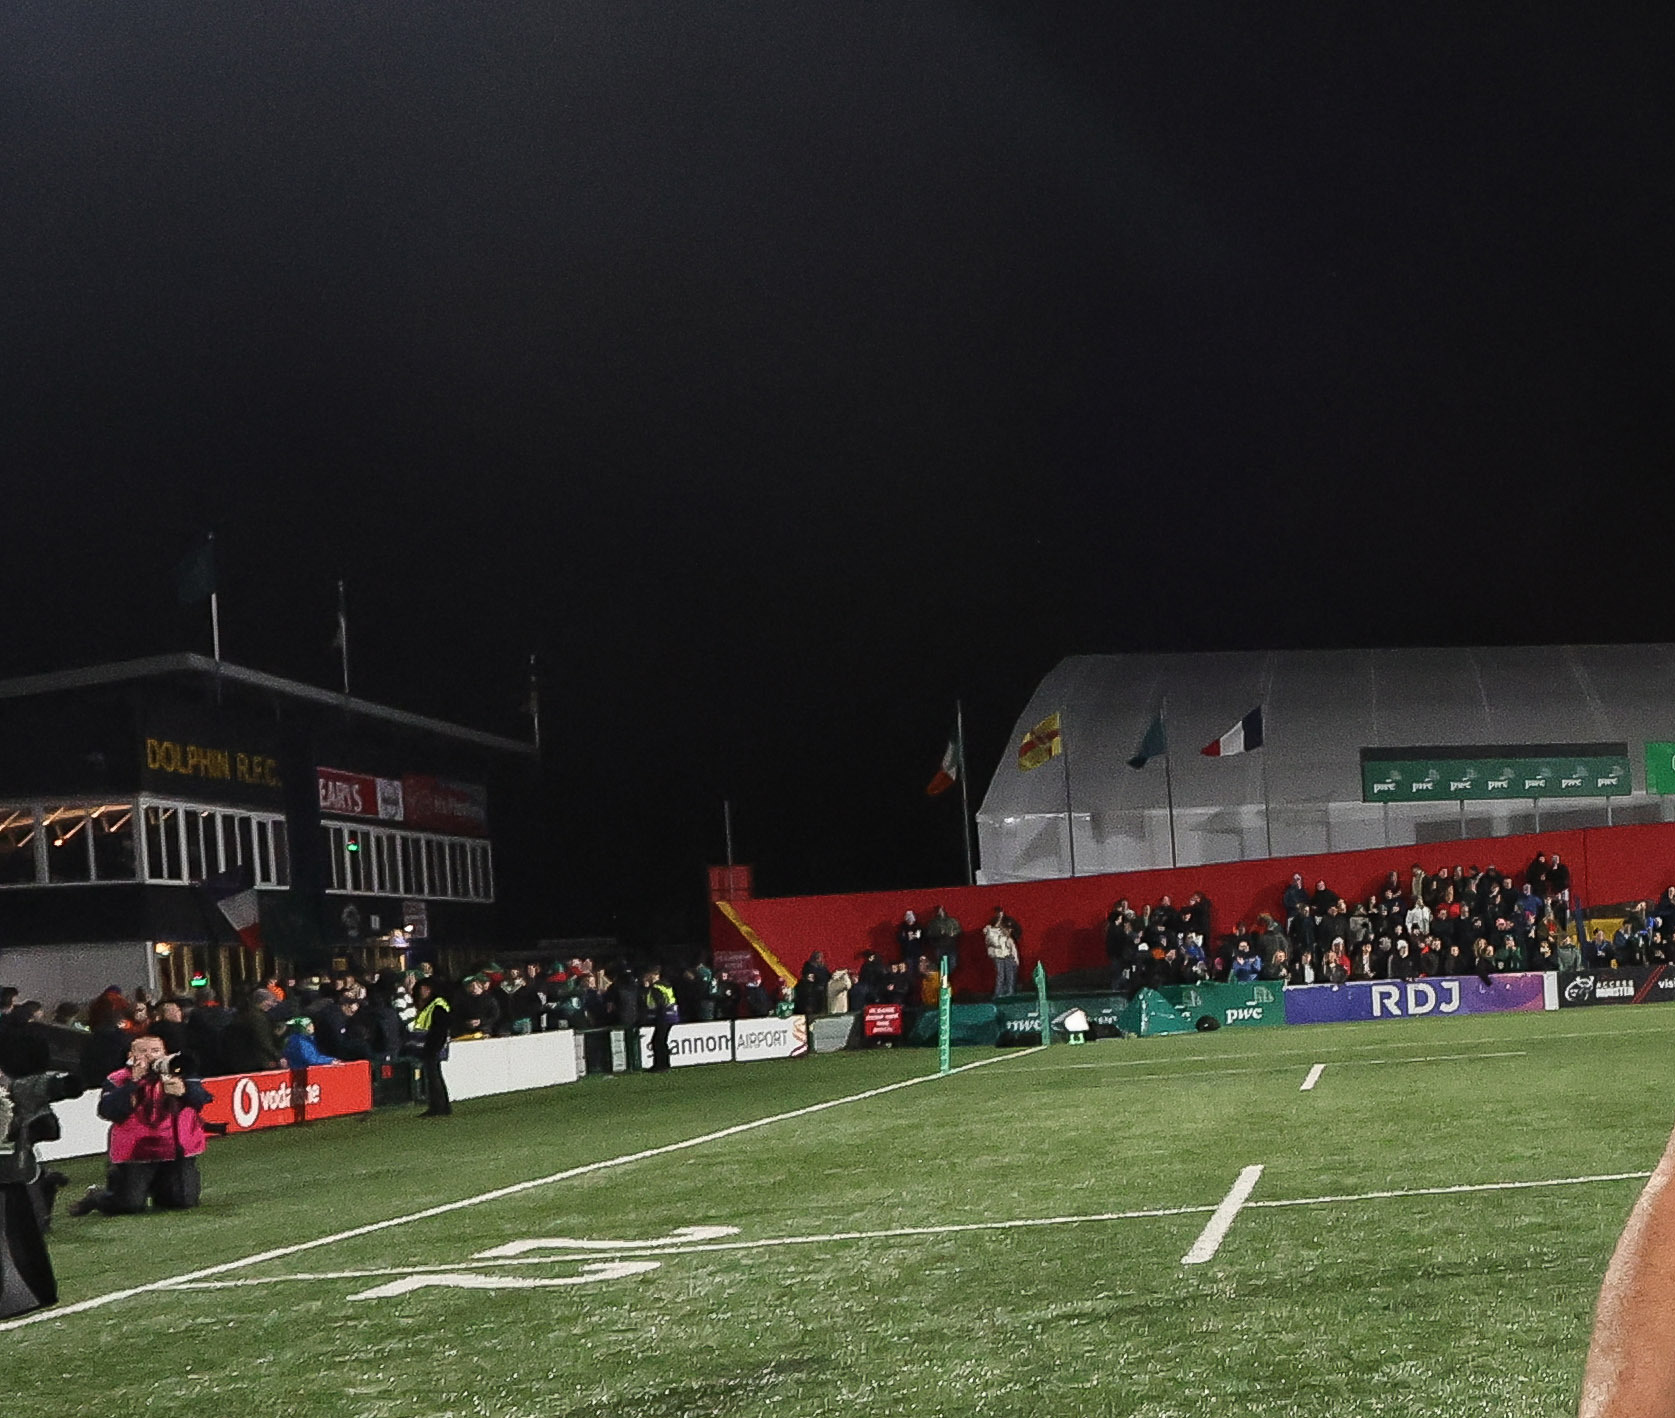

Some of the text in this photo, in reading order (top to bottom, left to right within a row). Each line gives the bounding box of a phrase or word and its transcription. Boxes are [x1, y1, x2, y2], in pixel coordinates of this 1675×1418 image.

[146, 737, 231, 781] DOLPHIN
[1225, 1007, 1263, 1025] pwc
[1372, 981, 1460, 1017] RDJ
